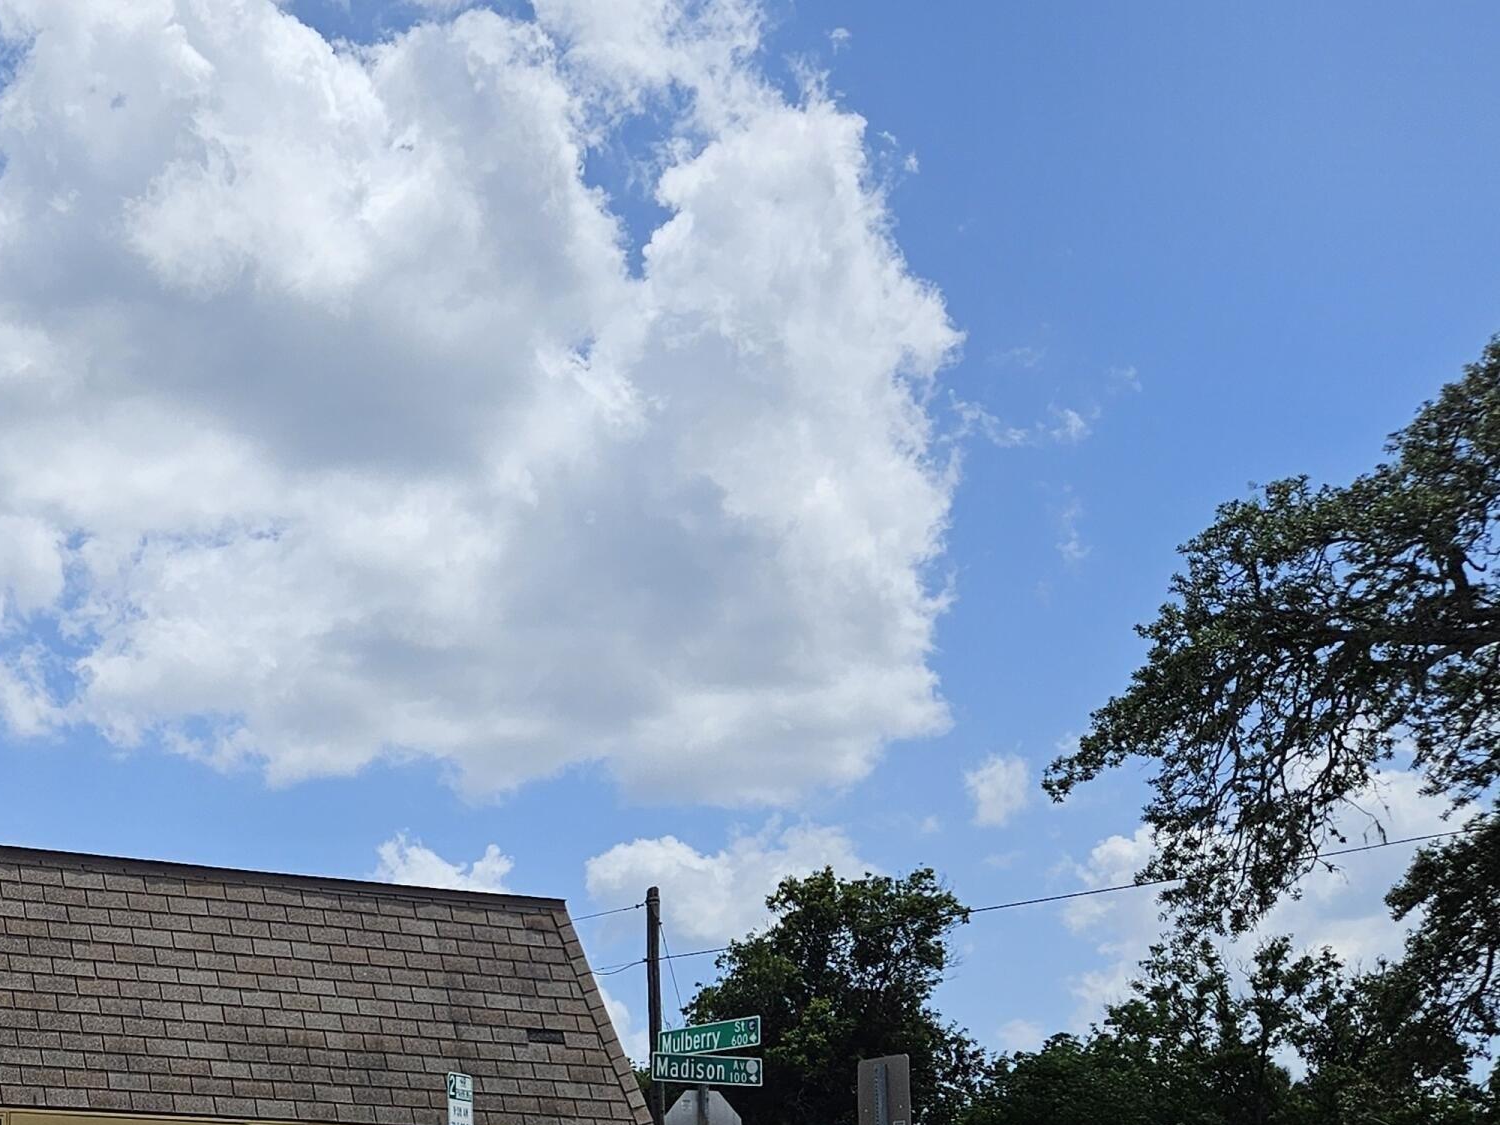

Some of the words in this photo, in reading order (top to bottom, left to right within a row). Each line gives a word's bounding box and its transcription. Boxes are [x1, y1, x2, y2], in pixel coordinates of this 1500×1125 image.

[734, 1021, 745, 1033] St
[661, 1030, 721, 1053] Mulberry
[731, 1034, 748, 1046] 600
[656, 1056, 725, 1080] Madison
[733, 1060, 745, 1070] Av
[730, 1072, 747, 1083] 100
[449, 1075, 456, 1096] 2
